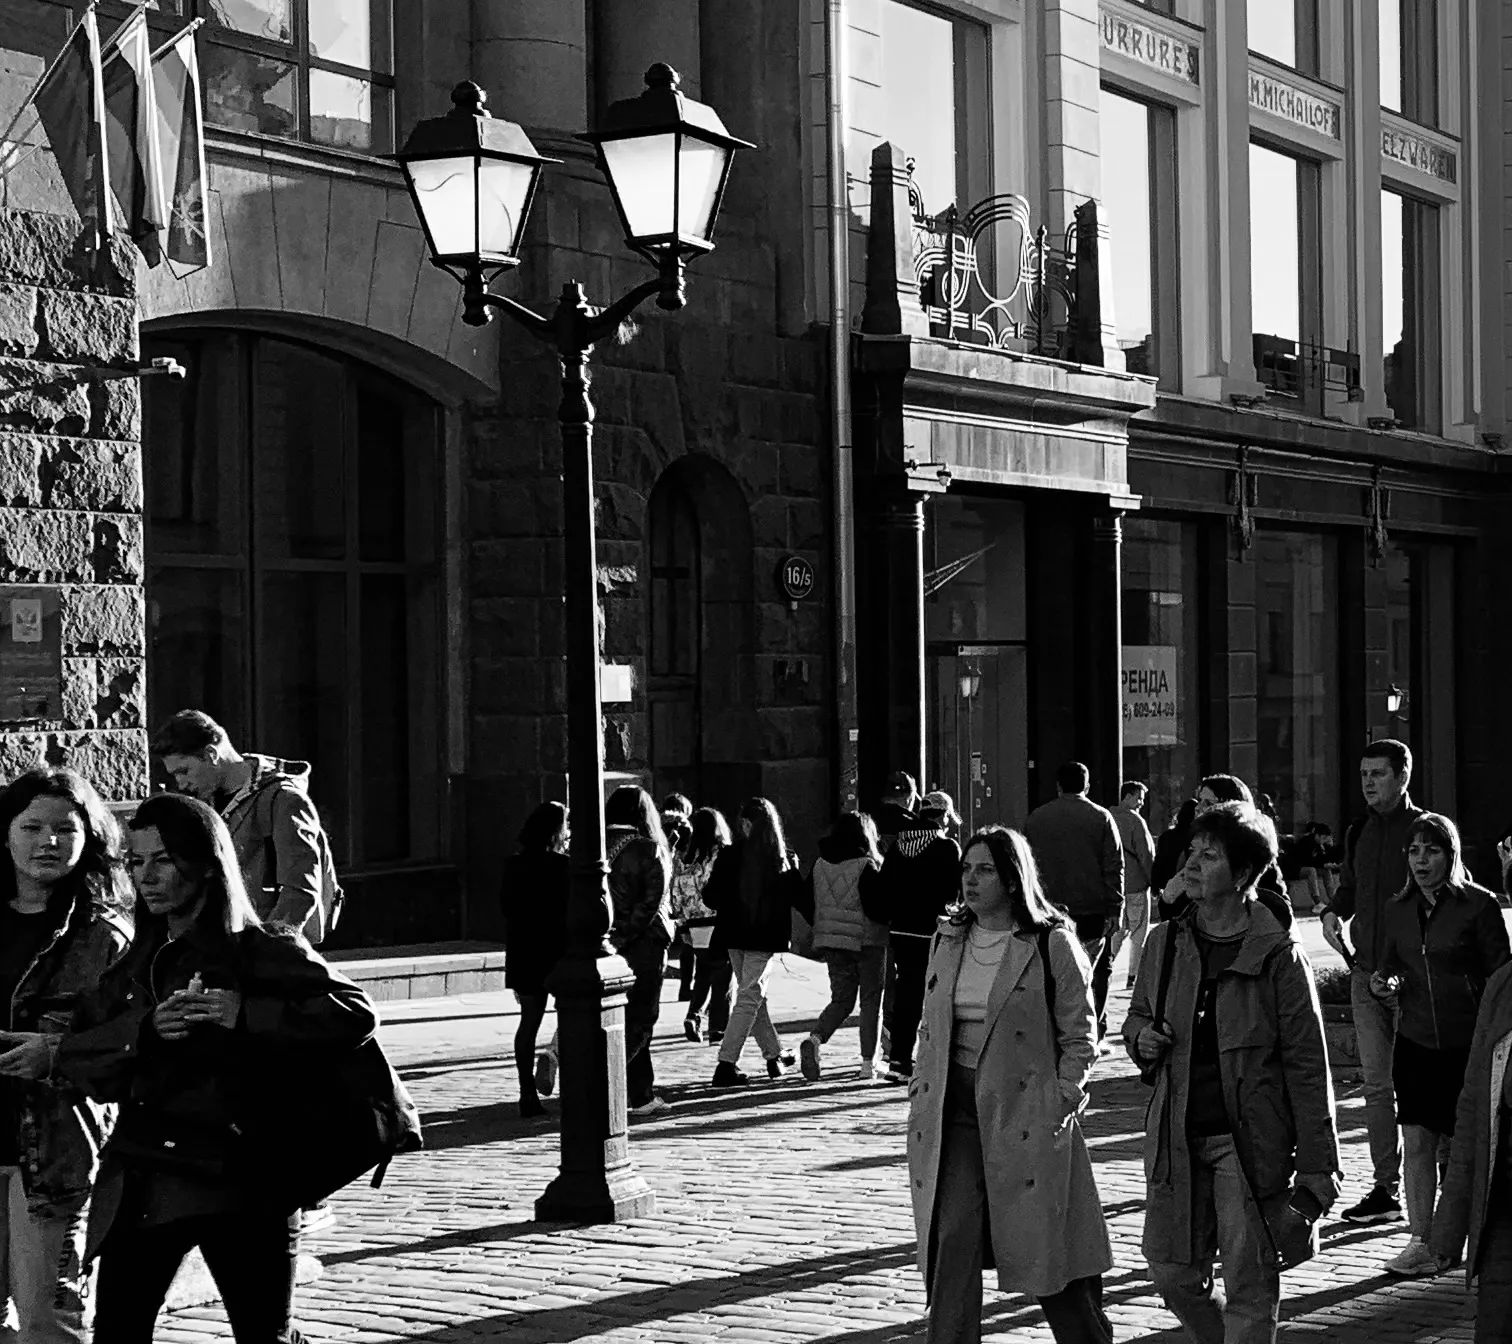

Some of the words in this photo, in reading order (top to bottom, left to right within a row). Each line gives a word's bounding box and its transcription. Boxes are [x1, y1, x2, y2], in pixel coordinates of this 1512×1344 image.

[1103, 15, 1195, 79] URRURES
[1383, 131, 1456, 182] ELZWAREN
[787, 566, 811, 587] 16/5
[1121, 669, 1169, 697] РЕНДА
